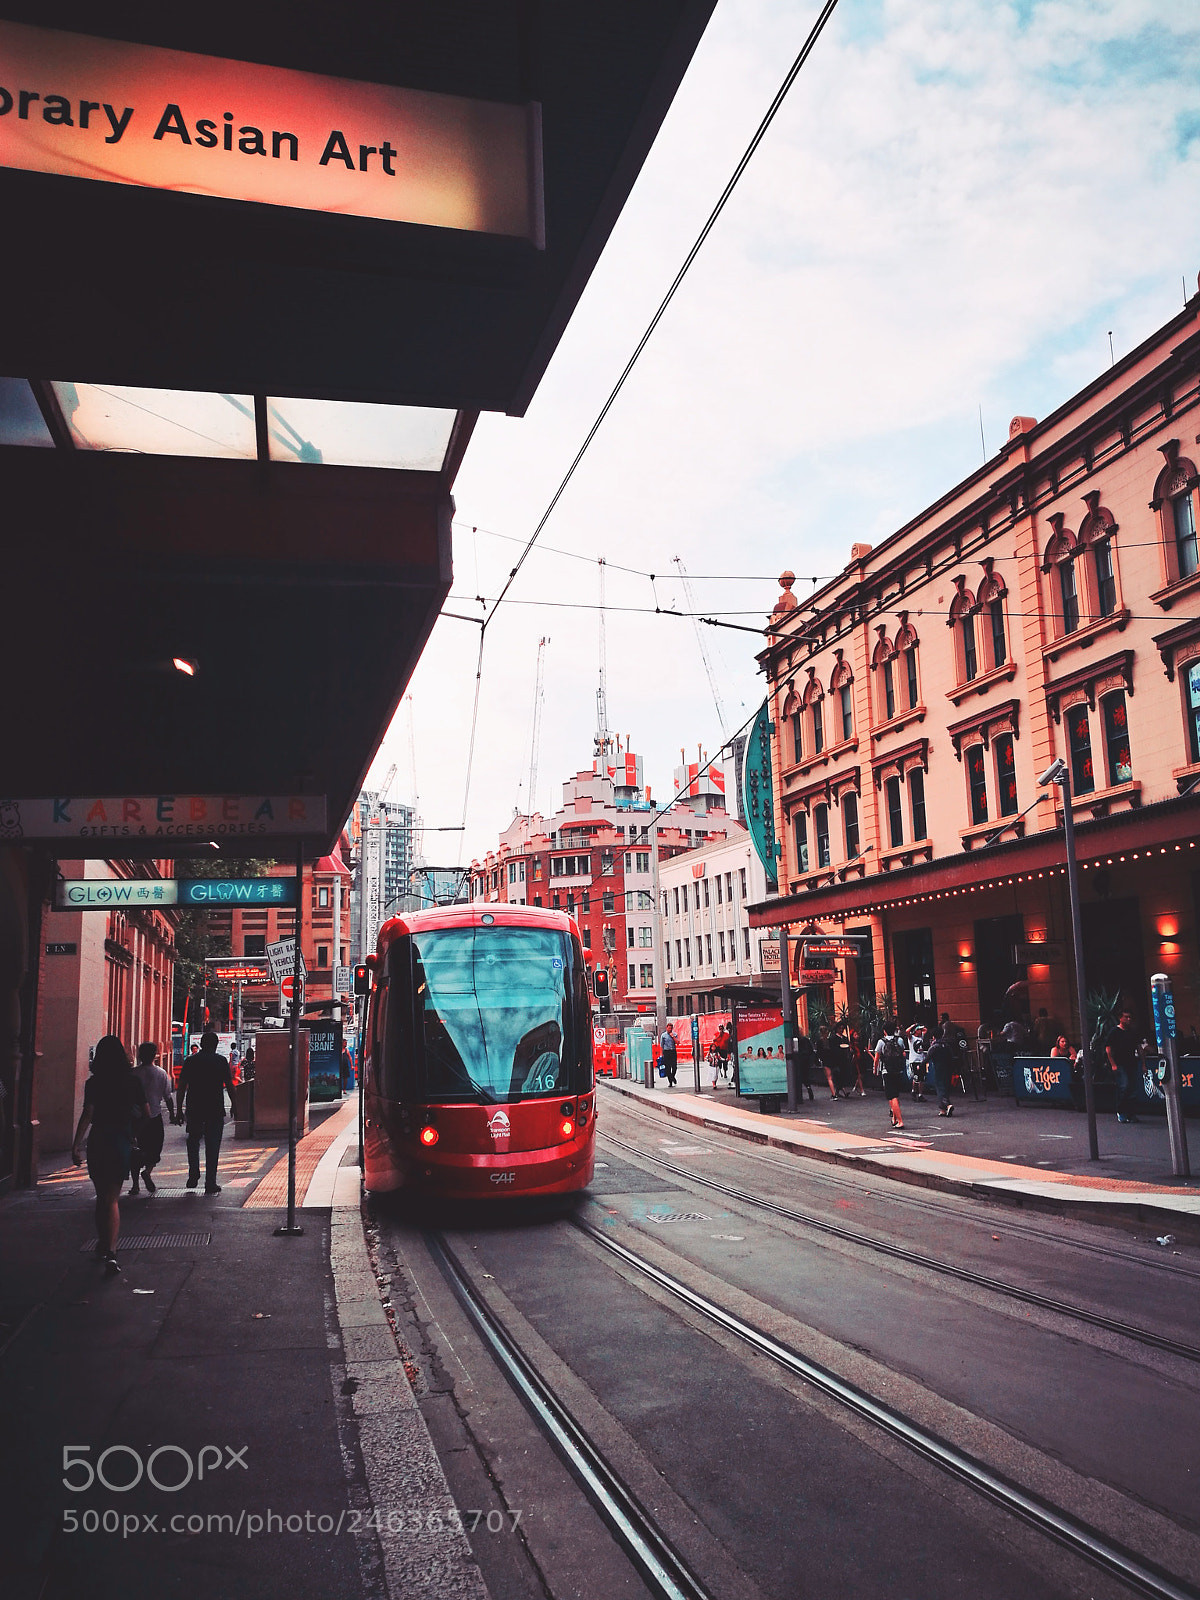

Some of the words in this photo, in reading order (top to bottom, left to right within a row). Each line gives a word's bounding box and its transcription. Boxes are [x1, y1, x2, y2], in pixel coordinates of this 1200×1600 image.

[153, 103, 299, 161] Asian
[318, 129, 398, 177] Art
[750, 768, 760, 818] HOTEL
[52, 796, 308, 824] KAREBEAR
[79, 825, 130, 837] GIFTS
[138, 824, 147, 836] &
[155, 822, 267, 836] ACCESSORIES
[68, 885, 133, 903] GLOW
[269, 946, 284, 957] LIGHT
[327, 1032, 335, 1041] IN
[535, 1074, 555, 1090] 16
[1032, 1065, 1061, 1091] Tiger
